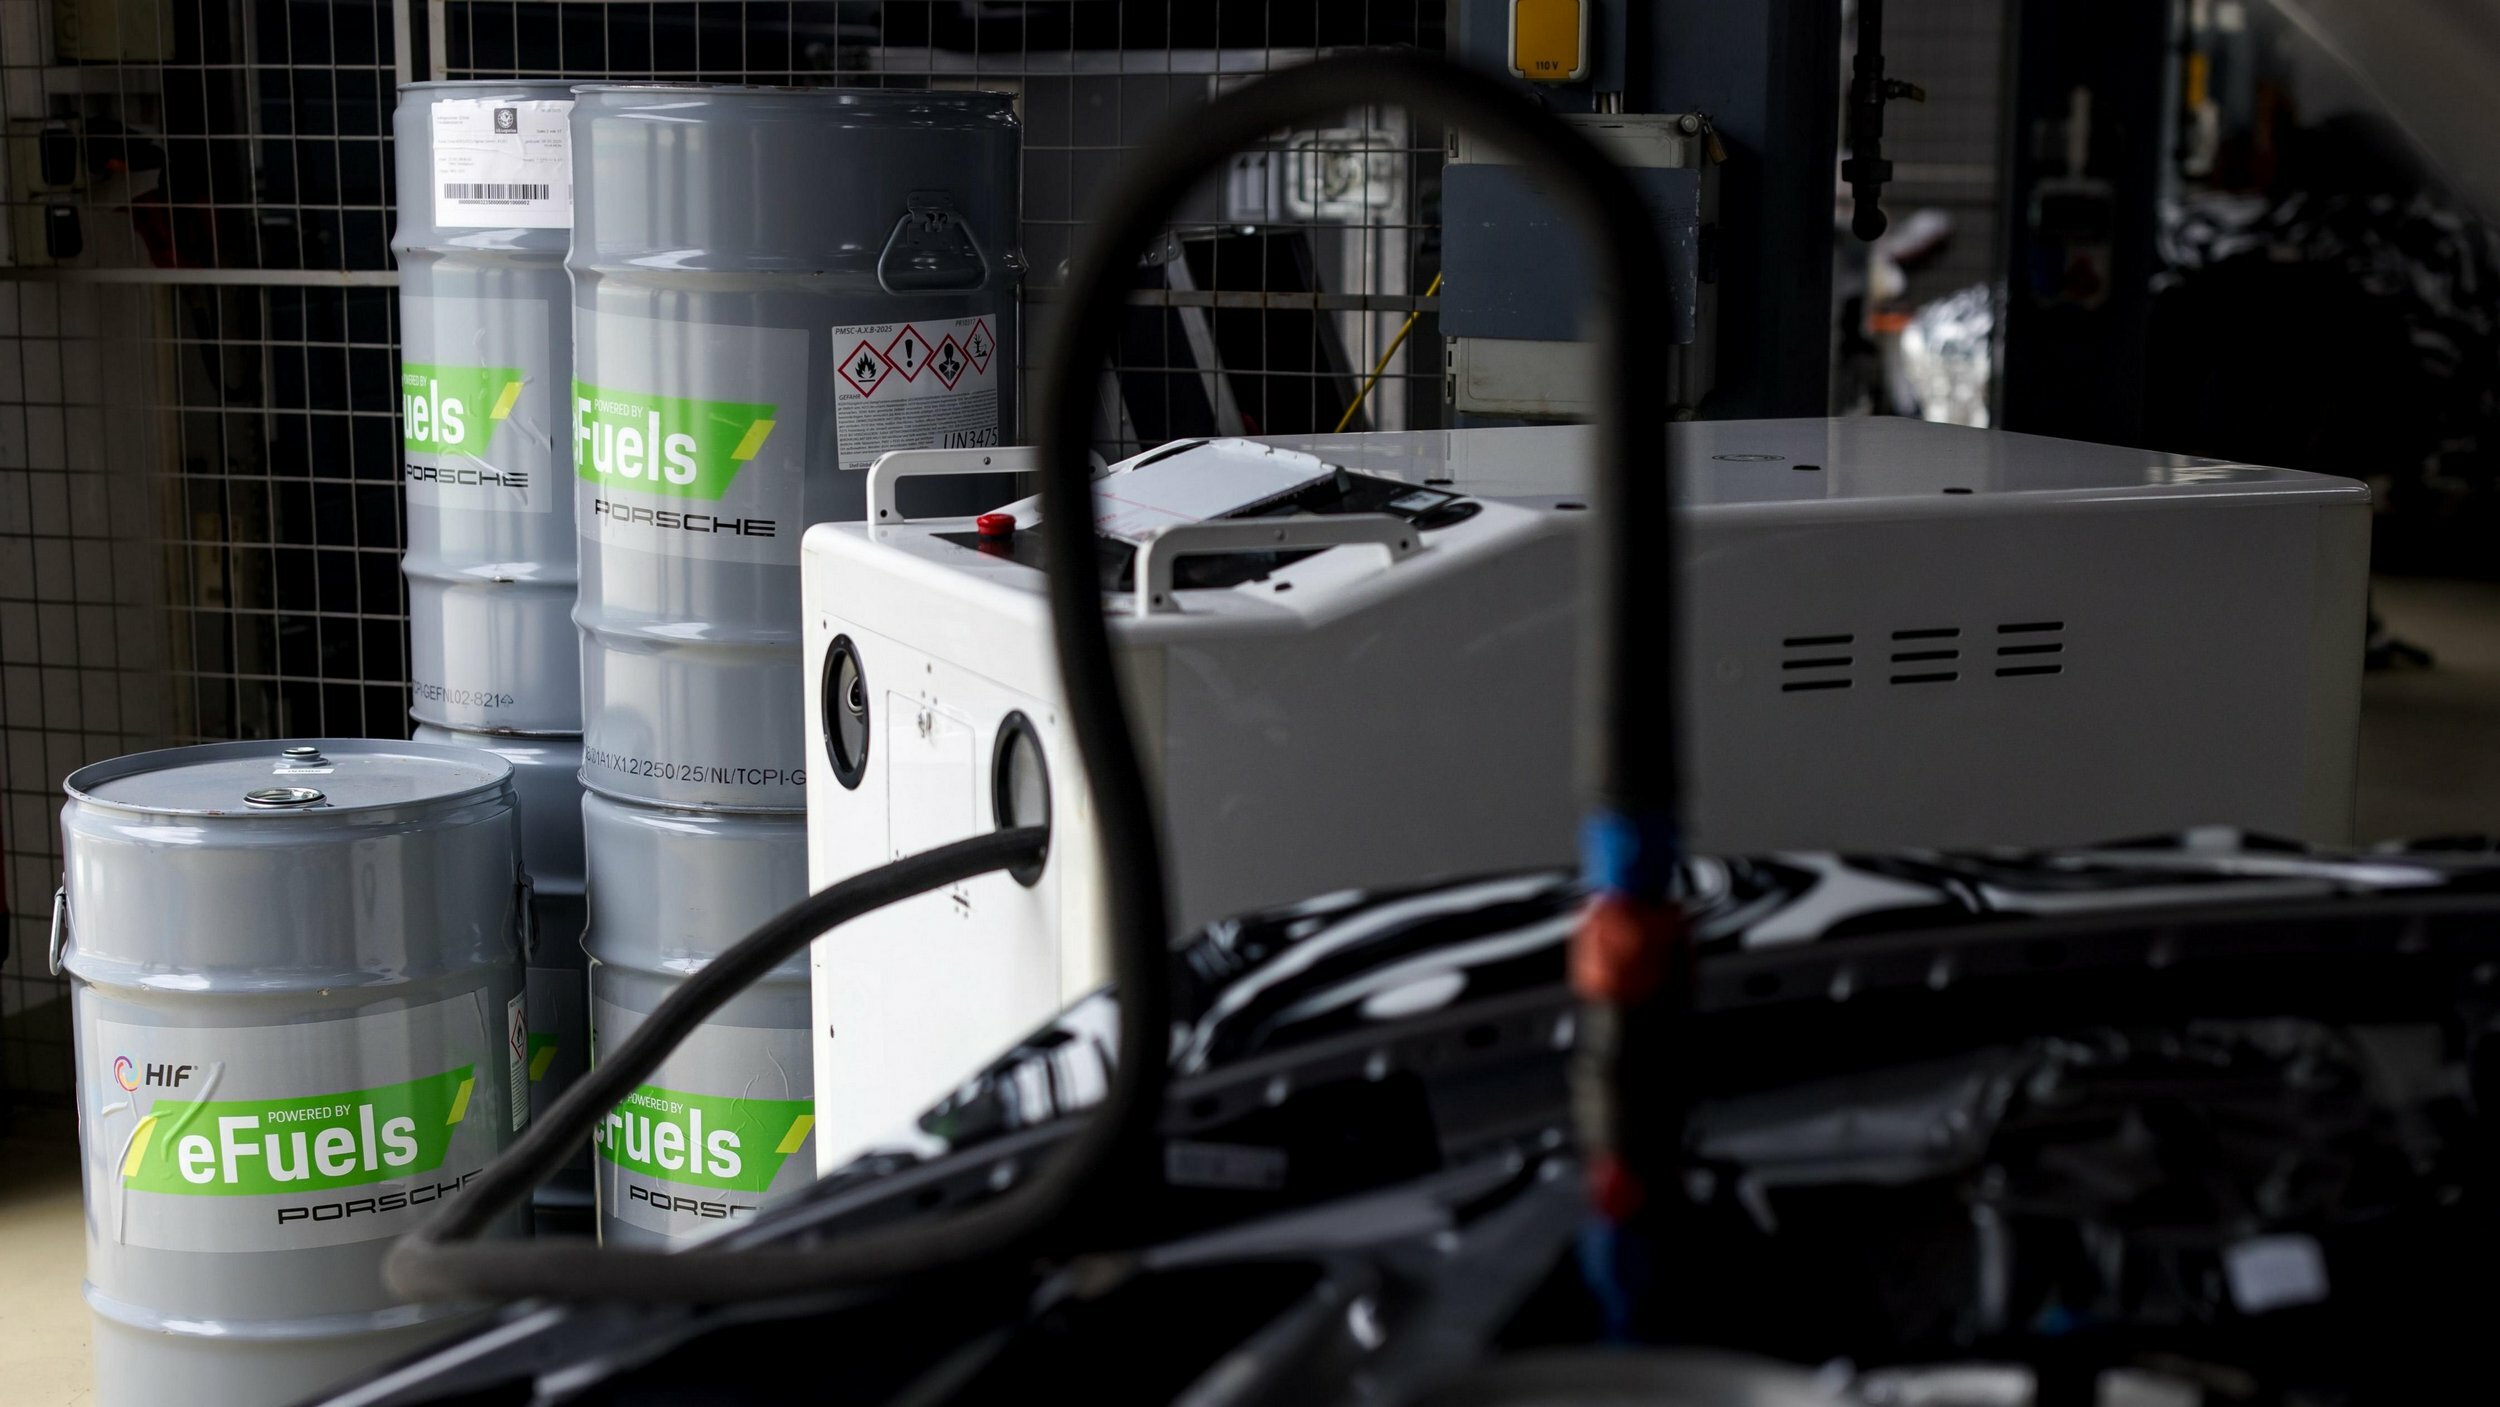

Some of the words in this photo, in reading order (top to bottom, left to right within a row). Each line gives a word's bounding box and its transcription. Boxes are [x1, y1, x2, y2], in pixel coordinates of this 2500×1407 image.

[1536, 61, 1550, 70] 110
[1552, 61, 1559, 70] V
[403, 379, 465, 444] uels
[594, 399, 629, 416] POWERED
[631, 404, 643, 418] BY
[943, 426, 998, 449] UN3475
[406, 463, 529, 488] PORSCHE
[595, 498, 776, 538] PORSCHE
[267, 1106, 332, 1124] POWERED
[335, 1104, 351, 1117] BY
[627, 1092, 669, 1112] POWERED
[670, 1101, 684, 1115] BY
[178, 1103, 418, 1184] eFuels
[629, 1184, 766, 1219] PORSC
